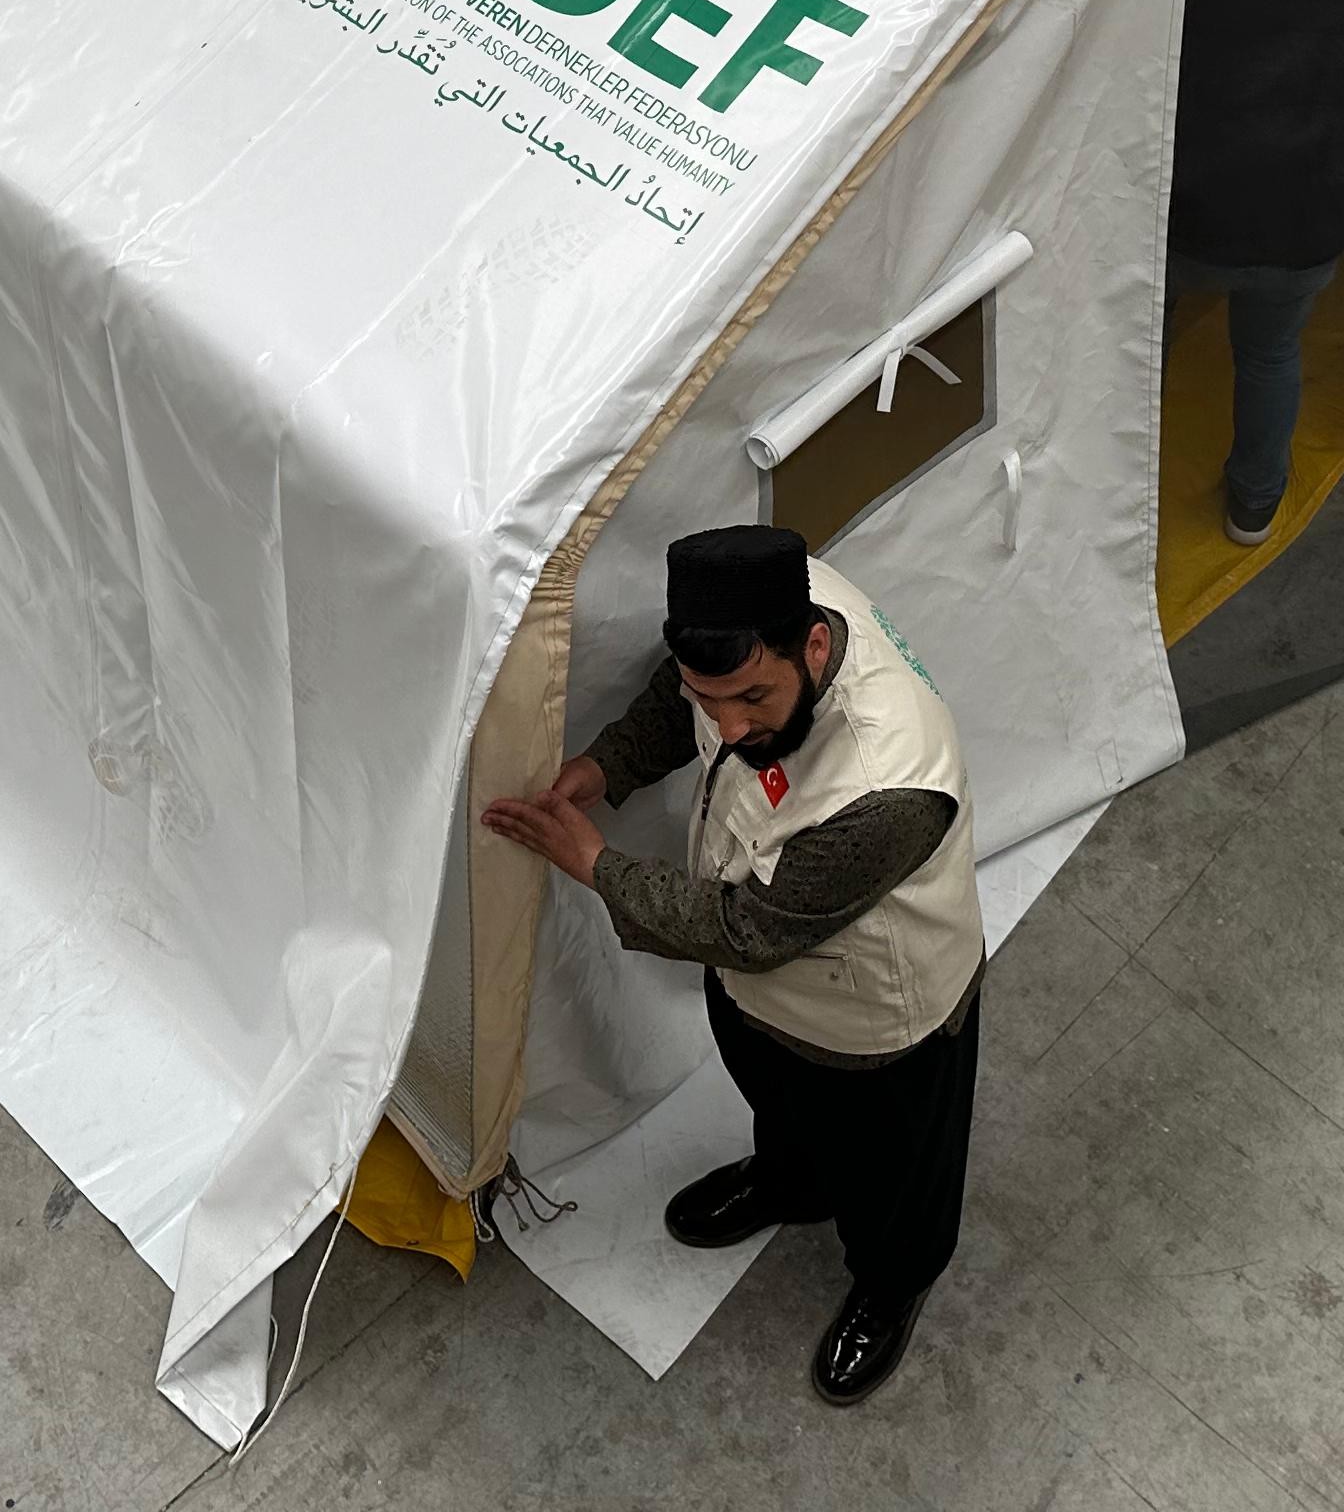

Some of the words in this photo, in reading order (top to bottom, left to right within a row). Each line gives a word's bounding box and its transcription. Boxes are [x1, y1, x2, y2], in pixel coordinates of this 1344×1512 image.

[432, 5, 455, 24] OF
[452, 16, 484, 44] THE
[476, 35, 579, 104] ASSOCIATIONS
[575, 94, 616, 126] THAT
[612, 116, 663, 157] VALUE
[657, 144, 735, 196] HUMANITY
[434, 79, 507, 112] التي
[501, 112, 631, 191] الجمعيات
[523, 24, 630, 99] DERNEKLER
[623, 87, 758, 172] FEDERASYONU
